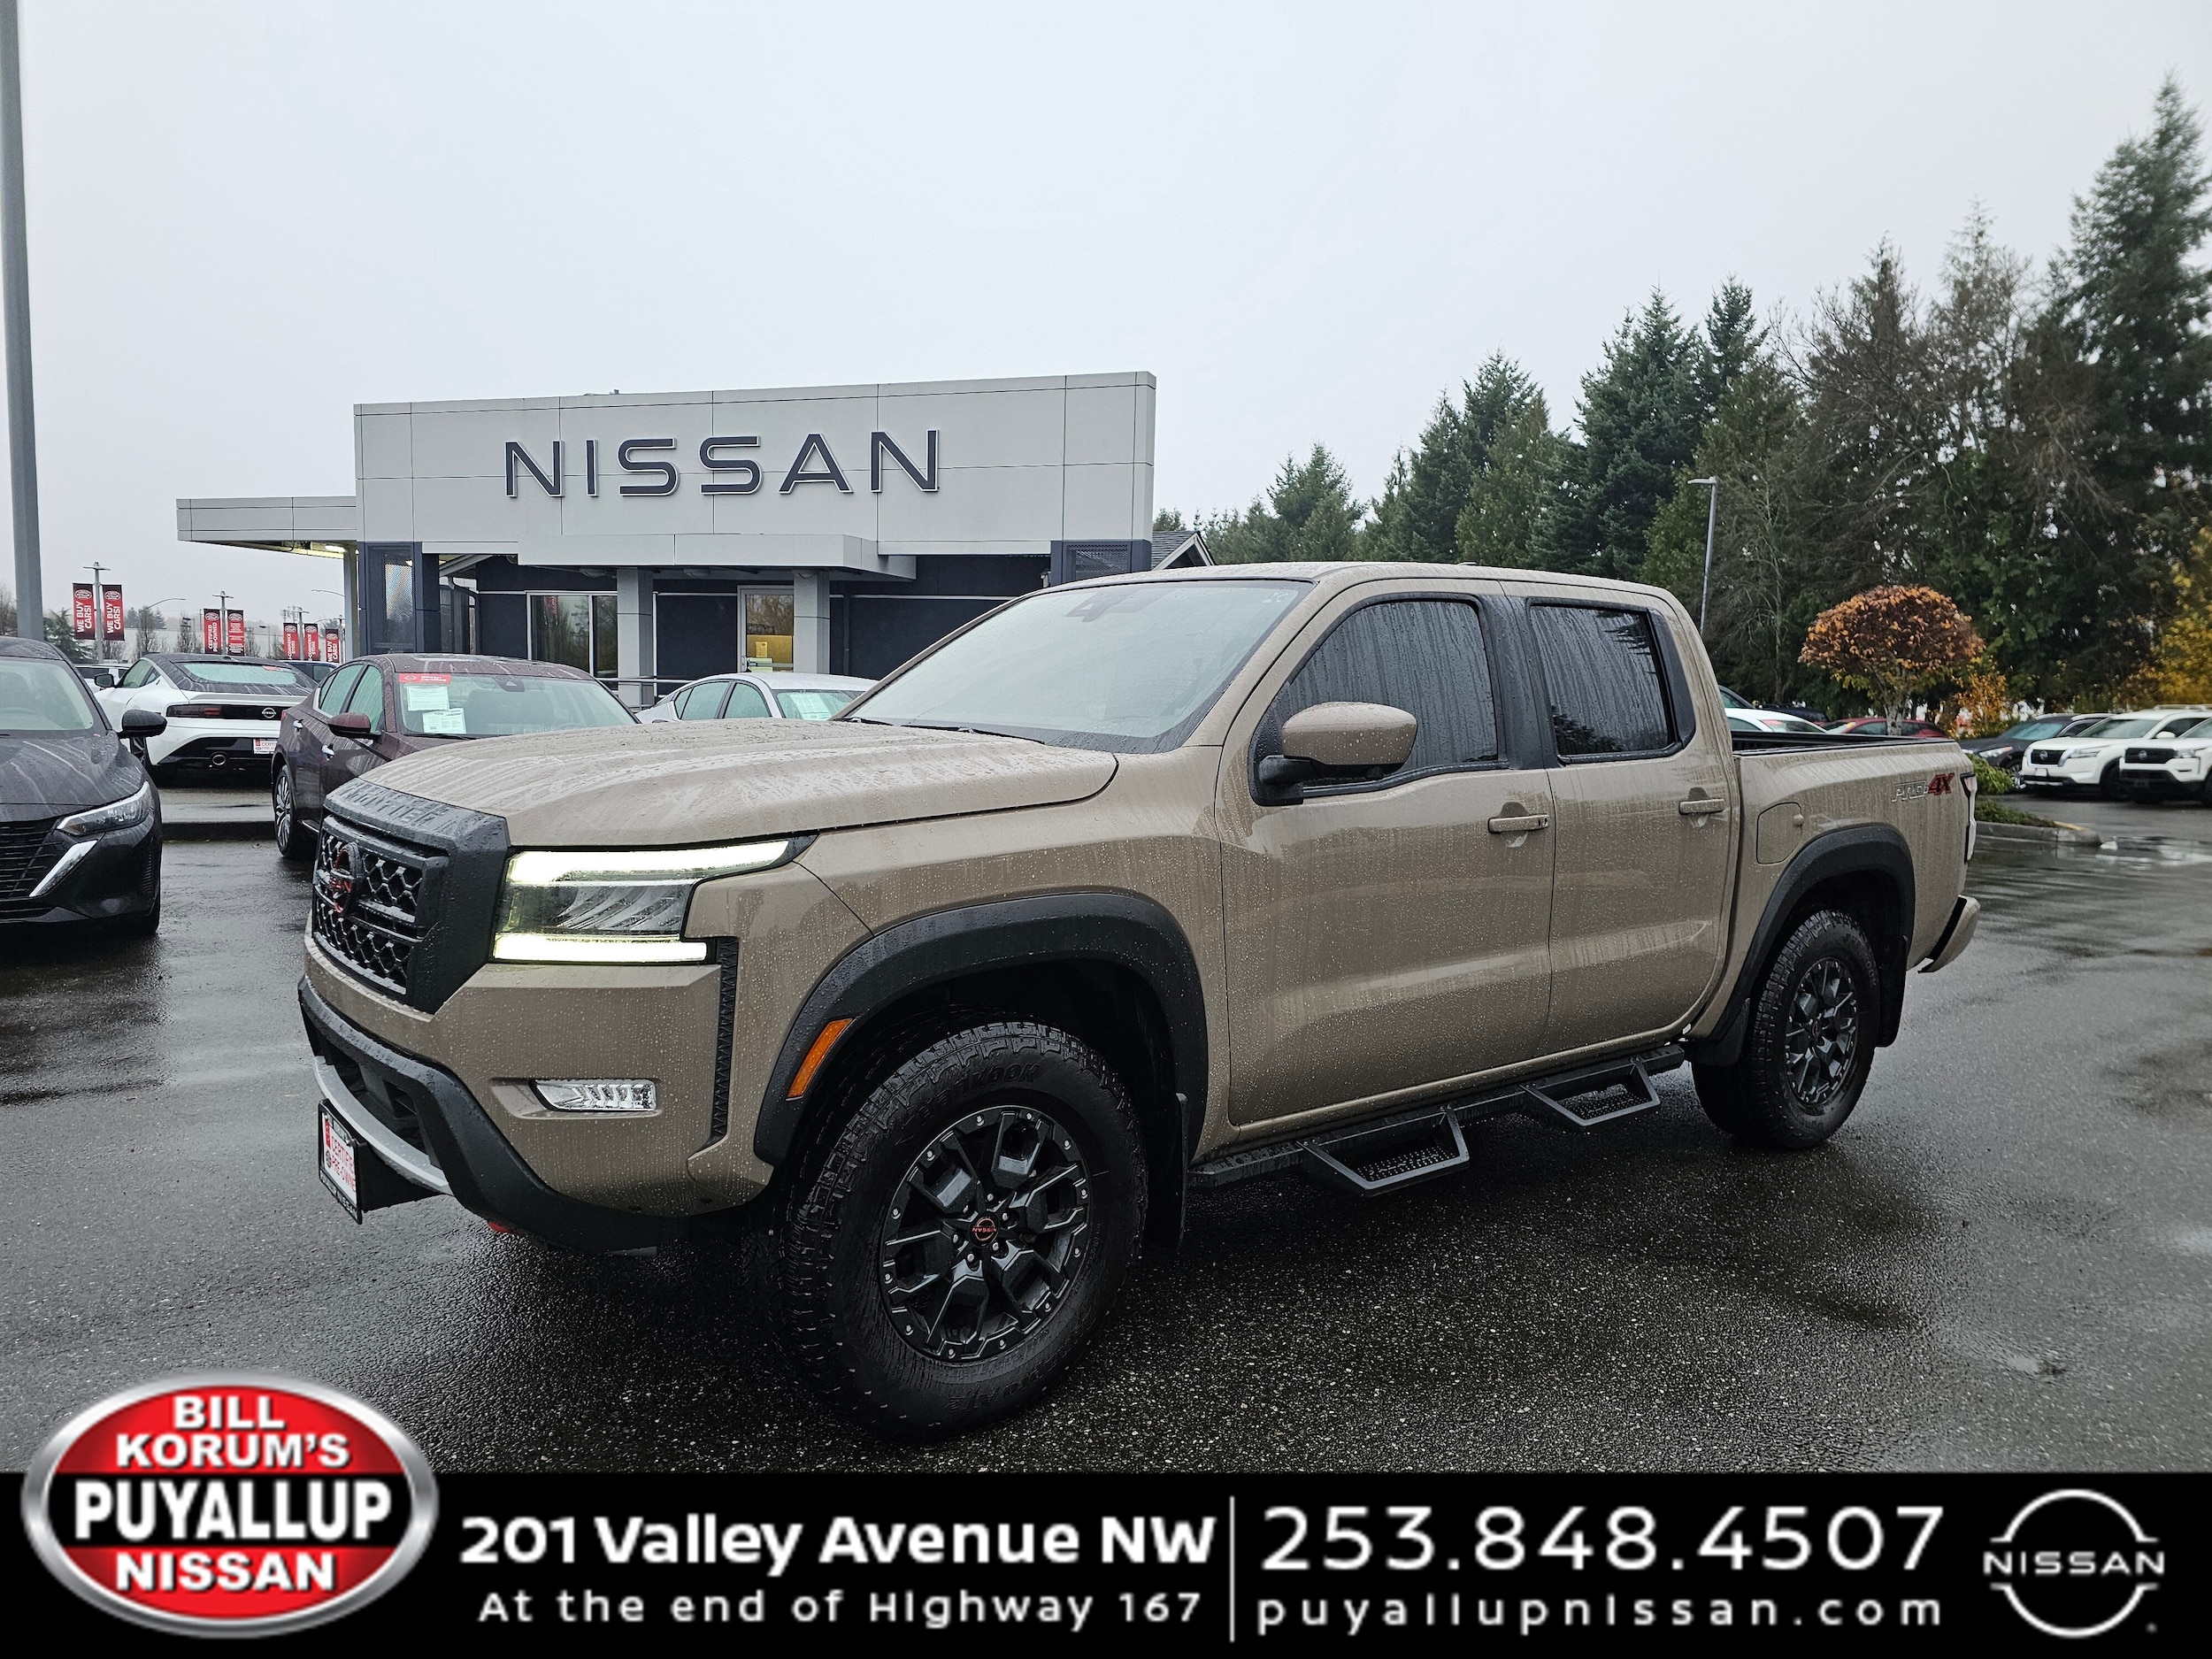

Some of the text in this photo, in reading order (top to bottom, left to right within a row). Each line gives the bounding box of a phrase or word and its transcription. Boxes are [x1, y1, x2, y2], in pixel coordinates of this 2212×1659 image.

[505, 429, 940, 497] NISSAN
[77, 619, 84, 633] WE
[107, 620, 114, 634] WE
